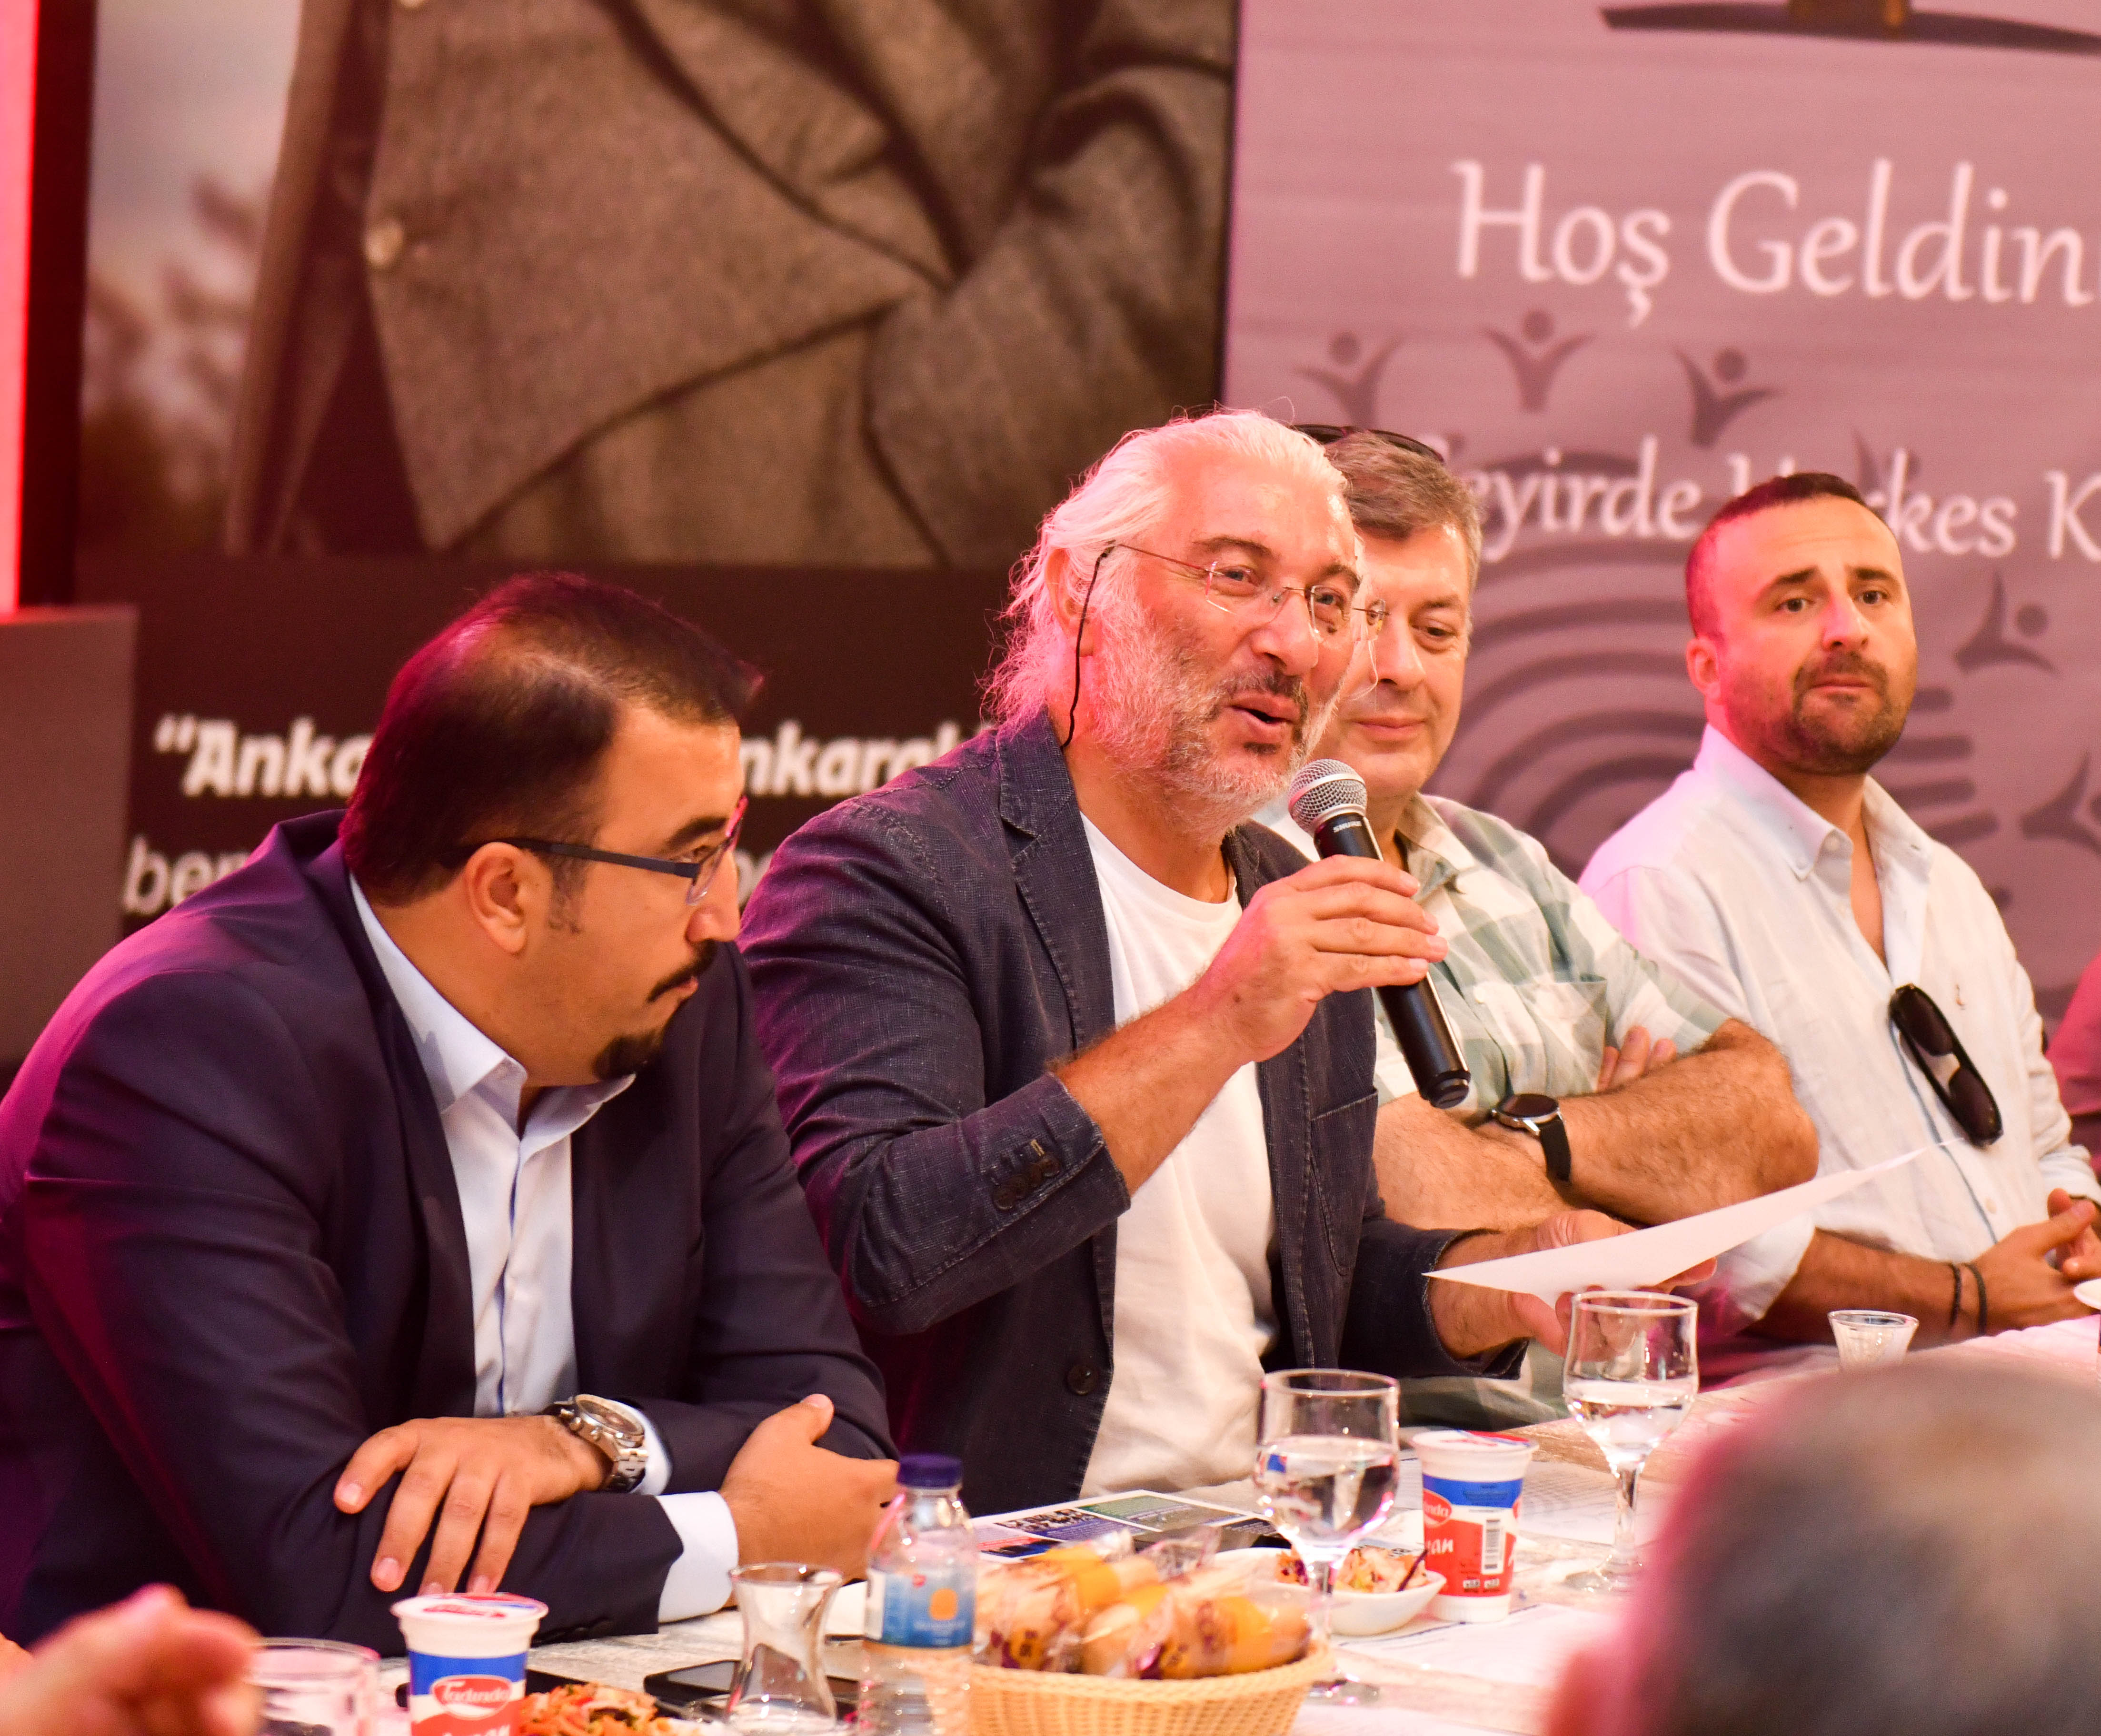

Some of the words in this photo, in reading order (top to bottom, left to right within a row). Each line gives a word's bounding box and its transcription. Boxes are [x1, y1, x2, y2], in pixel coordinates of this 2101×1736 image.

[1452, 160, 1672, 327] Hoş
[1707, 157, 2101, 307] Geldin
[1333, 821, 1362, 833] SHURE
